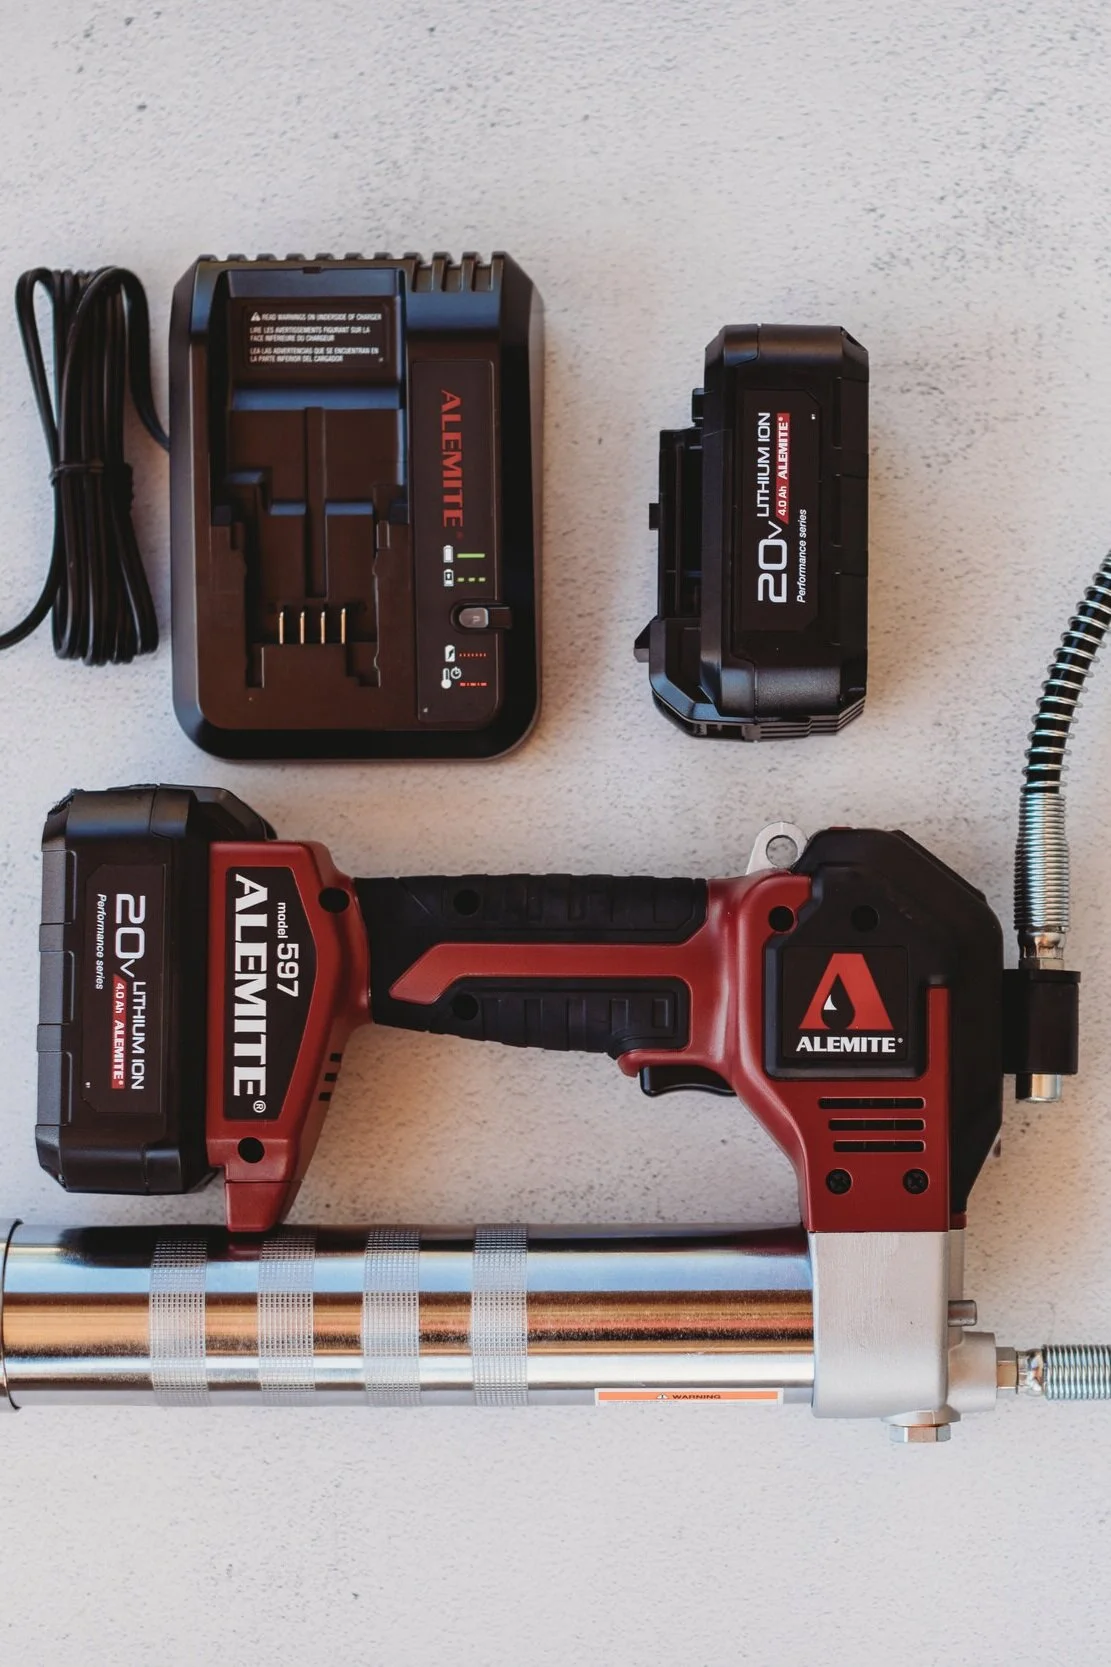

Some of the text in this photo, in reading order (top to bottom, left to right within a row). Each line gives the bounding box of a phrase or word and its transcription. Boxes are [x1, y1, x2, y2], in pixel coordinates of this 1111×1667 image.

[262, 313, 382, 321] READ WARNINGS ON UNDERSIDE OF CHARGER
[362, 326, 371, 334] LA
[314, 347, 325, 355] QUE
[326, 347, 333, 355] SE
[371, 347, 379, 355] EN
[758, 412, 771, 442] ION
[441, 389, 464, 527] ALEMITE
[757, 447, 770, 517] LITHIUM
[778, 486, 787, 499] Ah
[777, 500, 787, 516] 4.0
[796, 509, 807, 604] Performance series
[95, 893, 107, 990] Performance series
[276, 902, 299, 997] model 597
[115, 983, 125, 999] 4.0
[115, 1000, 124, 1014] Ah
[132, 981, 146, 1054] LITHIUM
[131, 1058, 145, 1090] ION
